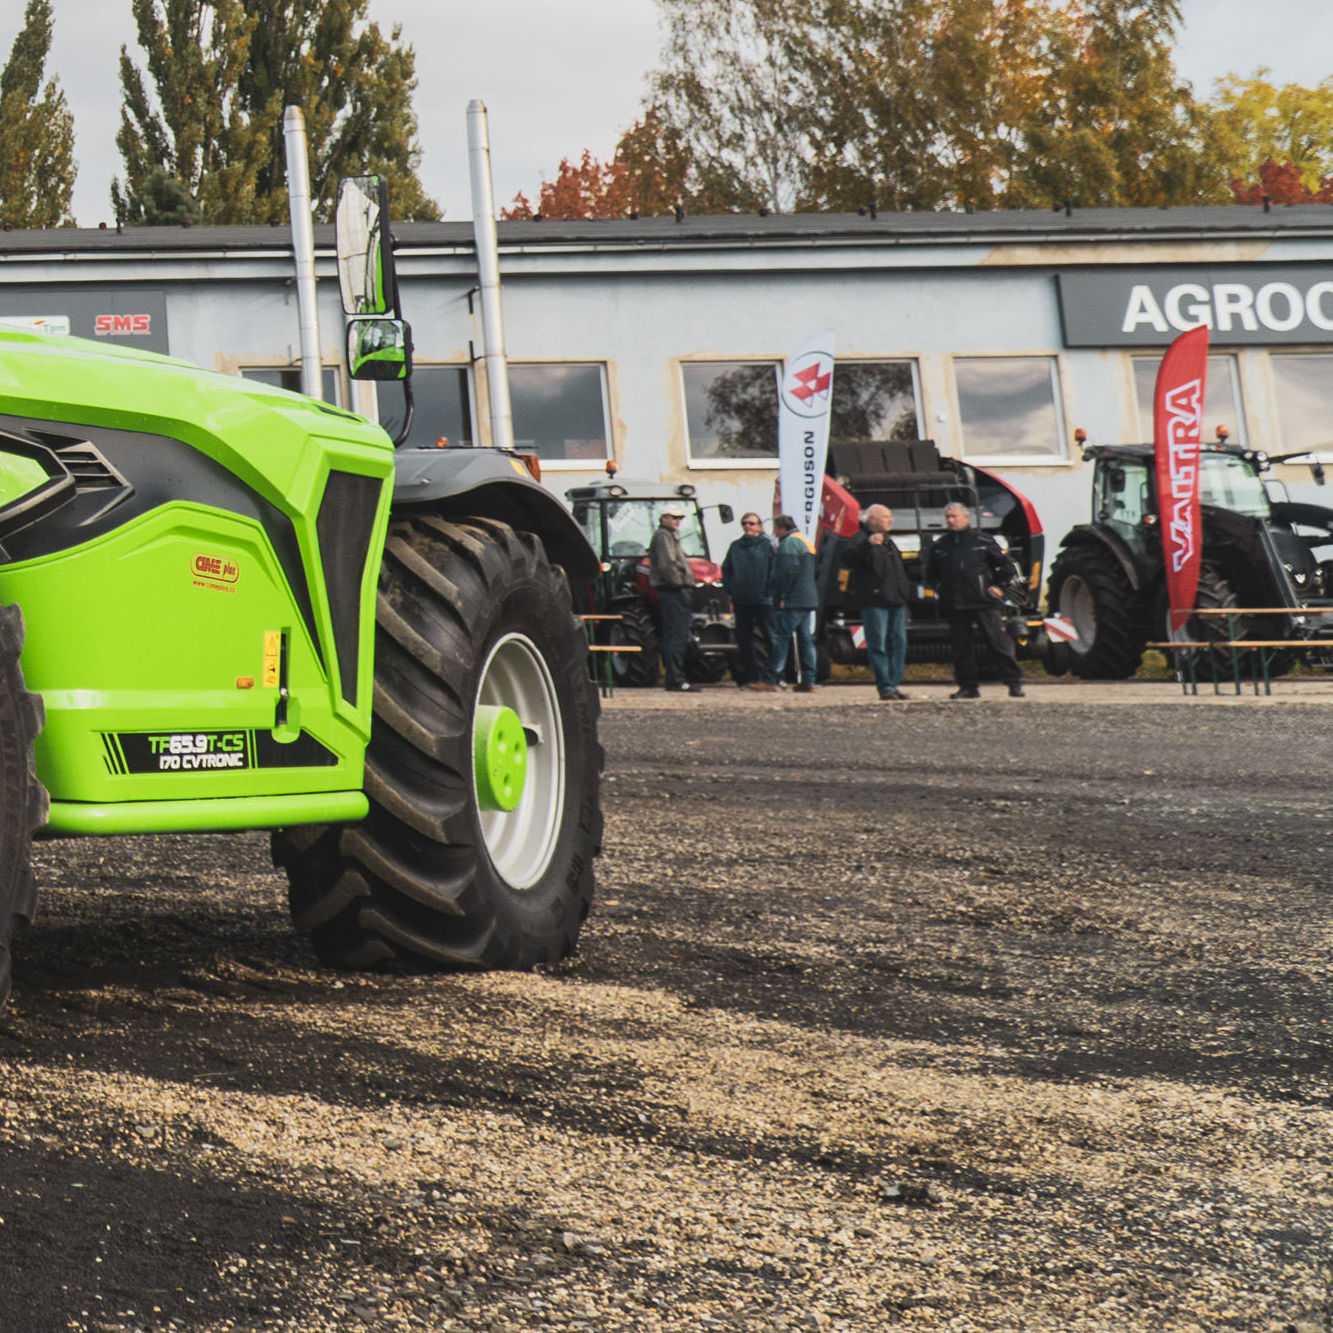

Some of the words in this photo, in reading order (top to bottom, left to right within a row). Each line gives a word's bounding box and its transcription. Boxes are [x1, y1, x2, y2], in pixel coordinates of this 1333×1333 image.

[95, 315, 151, 334] SMS
[1165, 378, 1202, 572] VALTRA
[148, 733, 244, 754] TF65.9T-CS
[159, 755, 181, 769] 170
[182, 753, 244, 769] CVTRONIC
